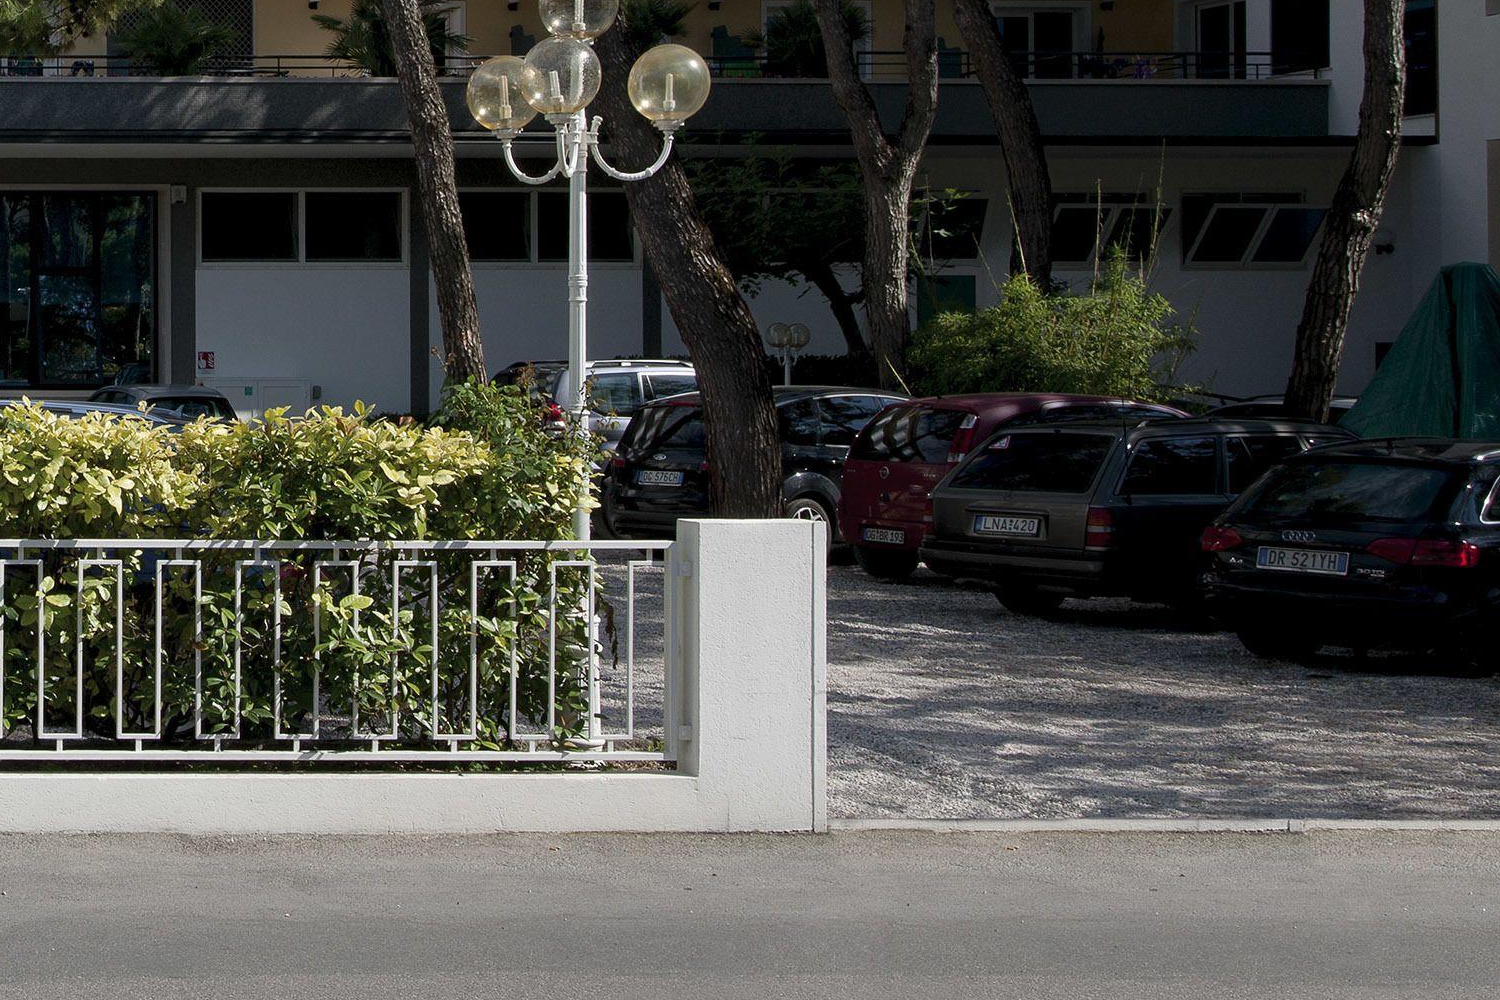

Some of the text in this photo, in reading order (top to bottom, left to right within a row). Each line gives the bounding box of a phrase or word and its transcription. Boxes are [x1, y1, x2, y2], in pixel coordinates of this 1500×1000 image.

[1012, 519, 1036, 532] 420
[1268, 551, 1338, 570] DR 521YH
